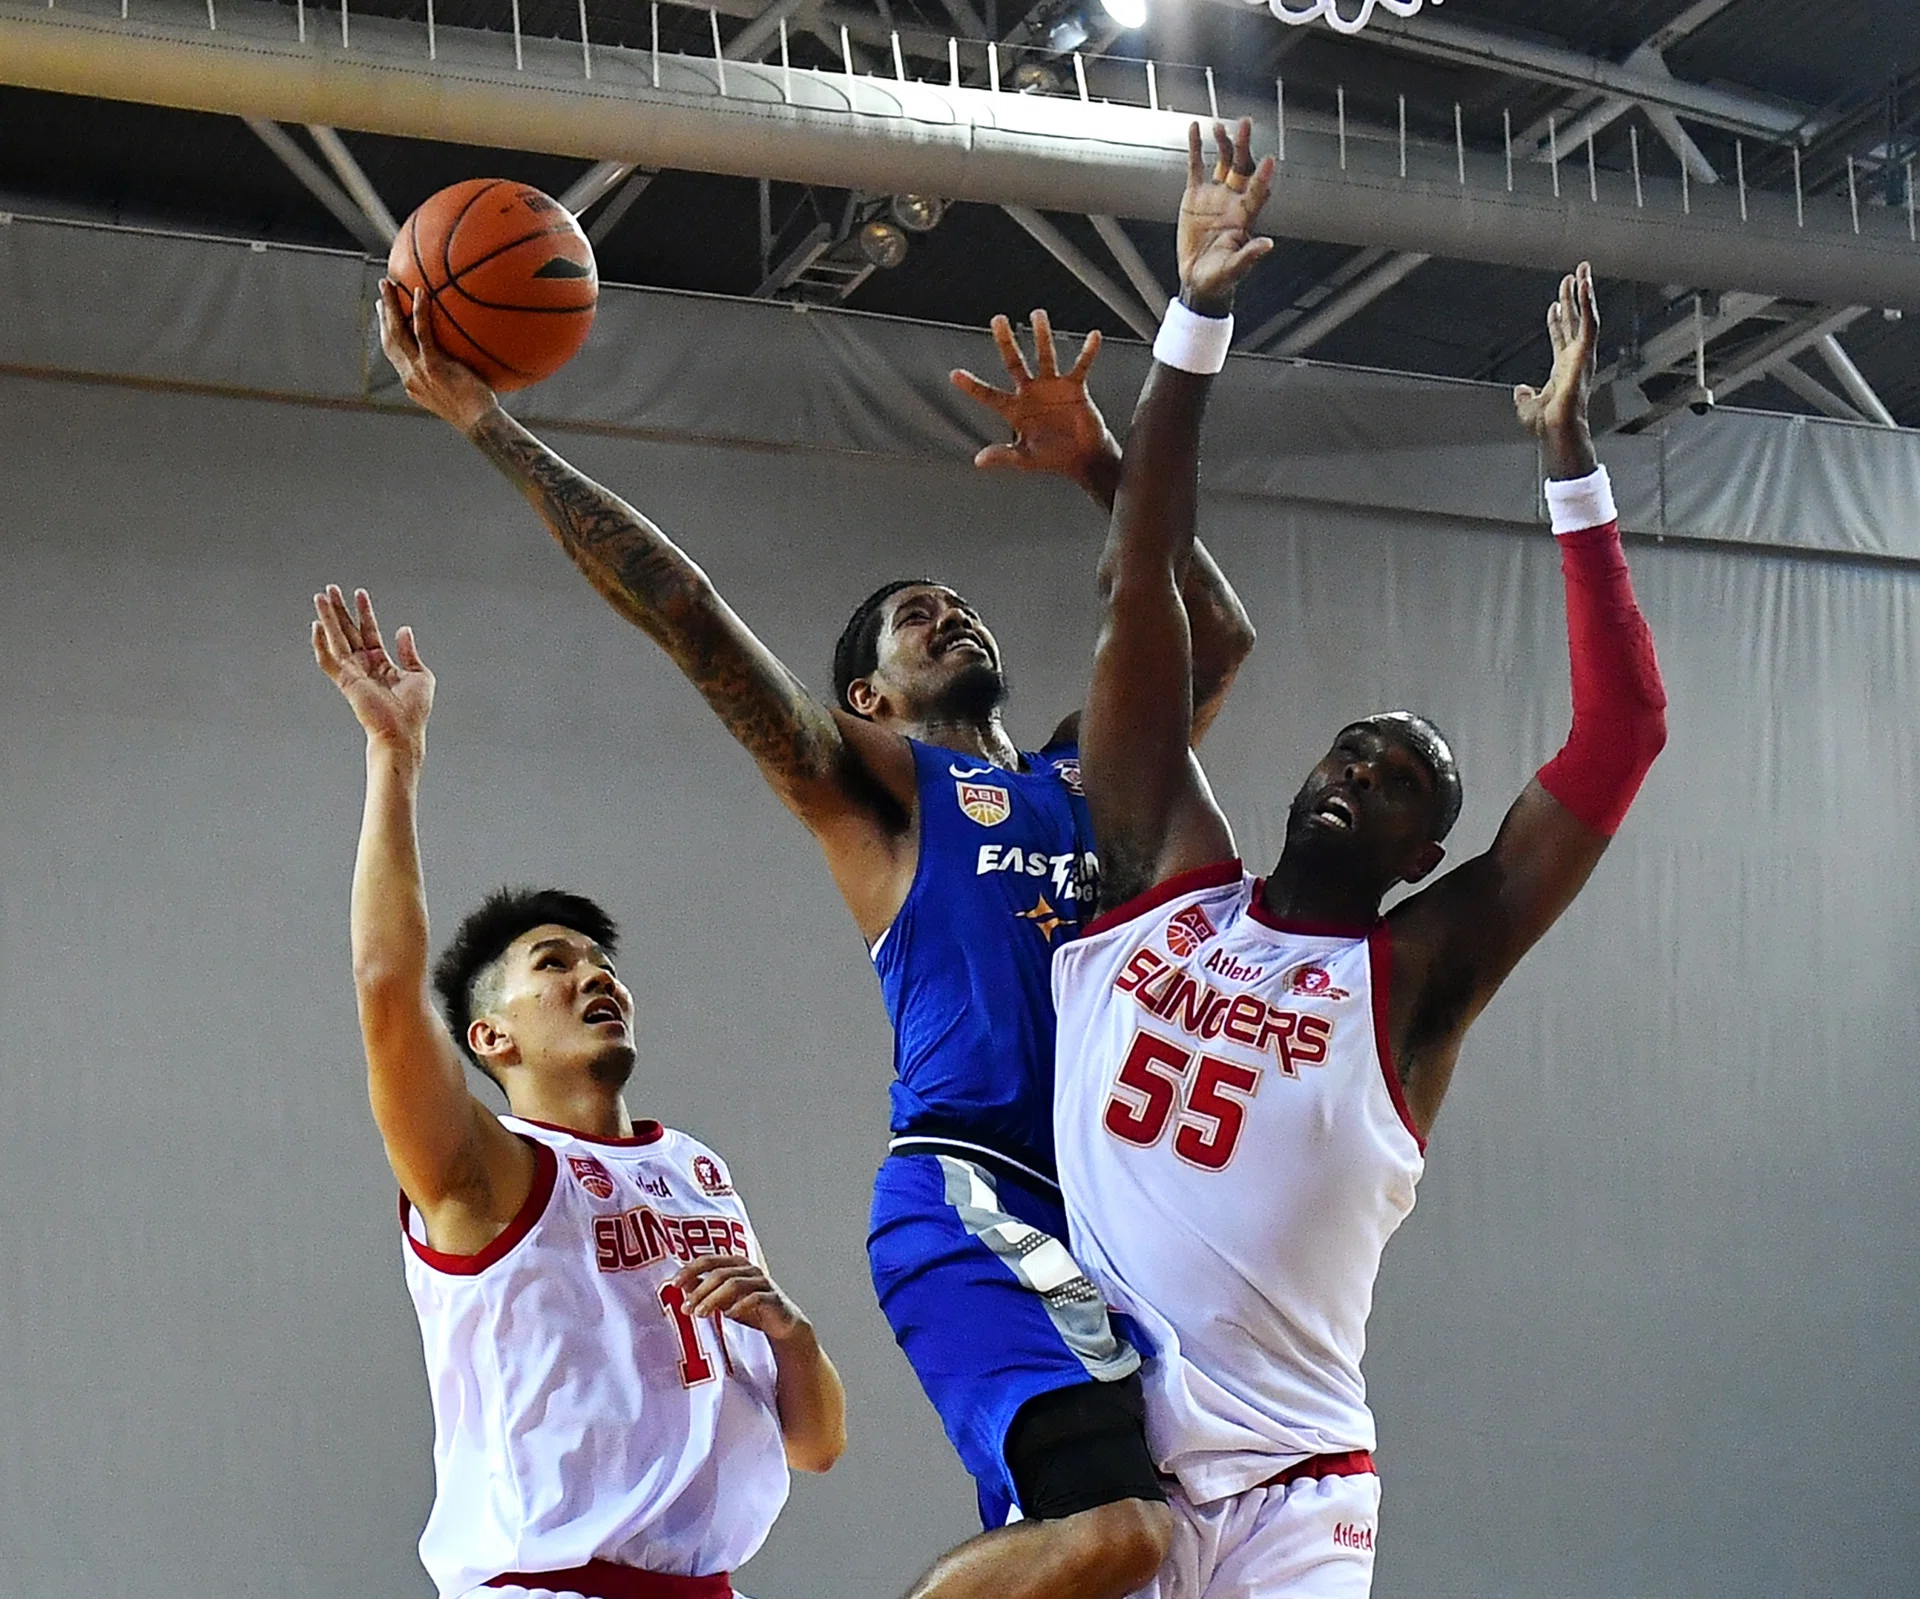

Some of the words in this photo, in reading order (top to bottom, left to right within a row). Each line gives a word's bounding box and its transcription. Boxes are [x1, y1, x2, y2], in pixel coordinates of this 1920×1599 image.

[965, 788, 1005, 805] ABL
[1103, 1027, 1263, 1173] 55
[592, 1205, 750, 1272] SLINGERS
[1333, 1522, 1374, 1552] AtletA
